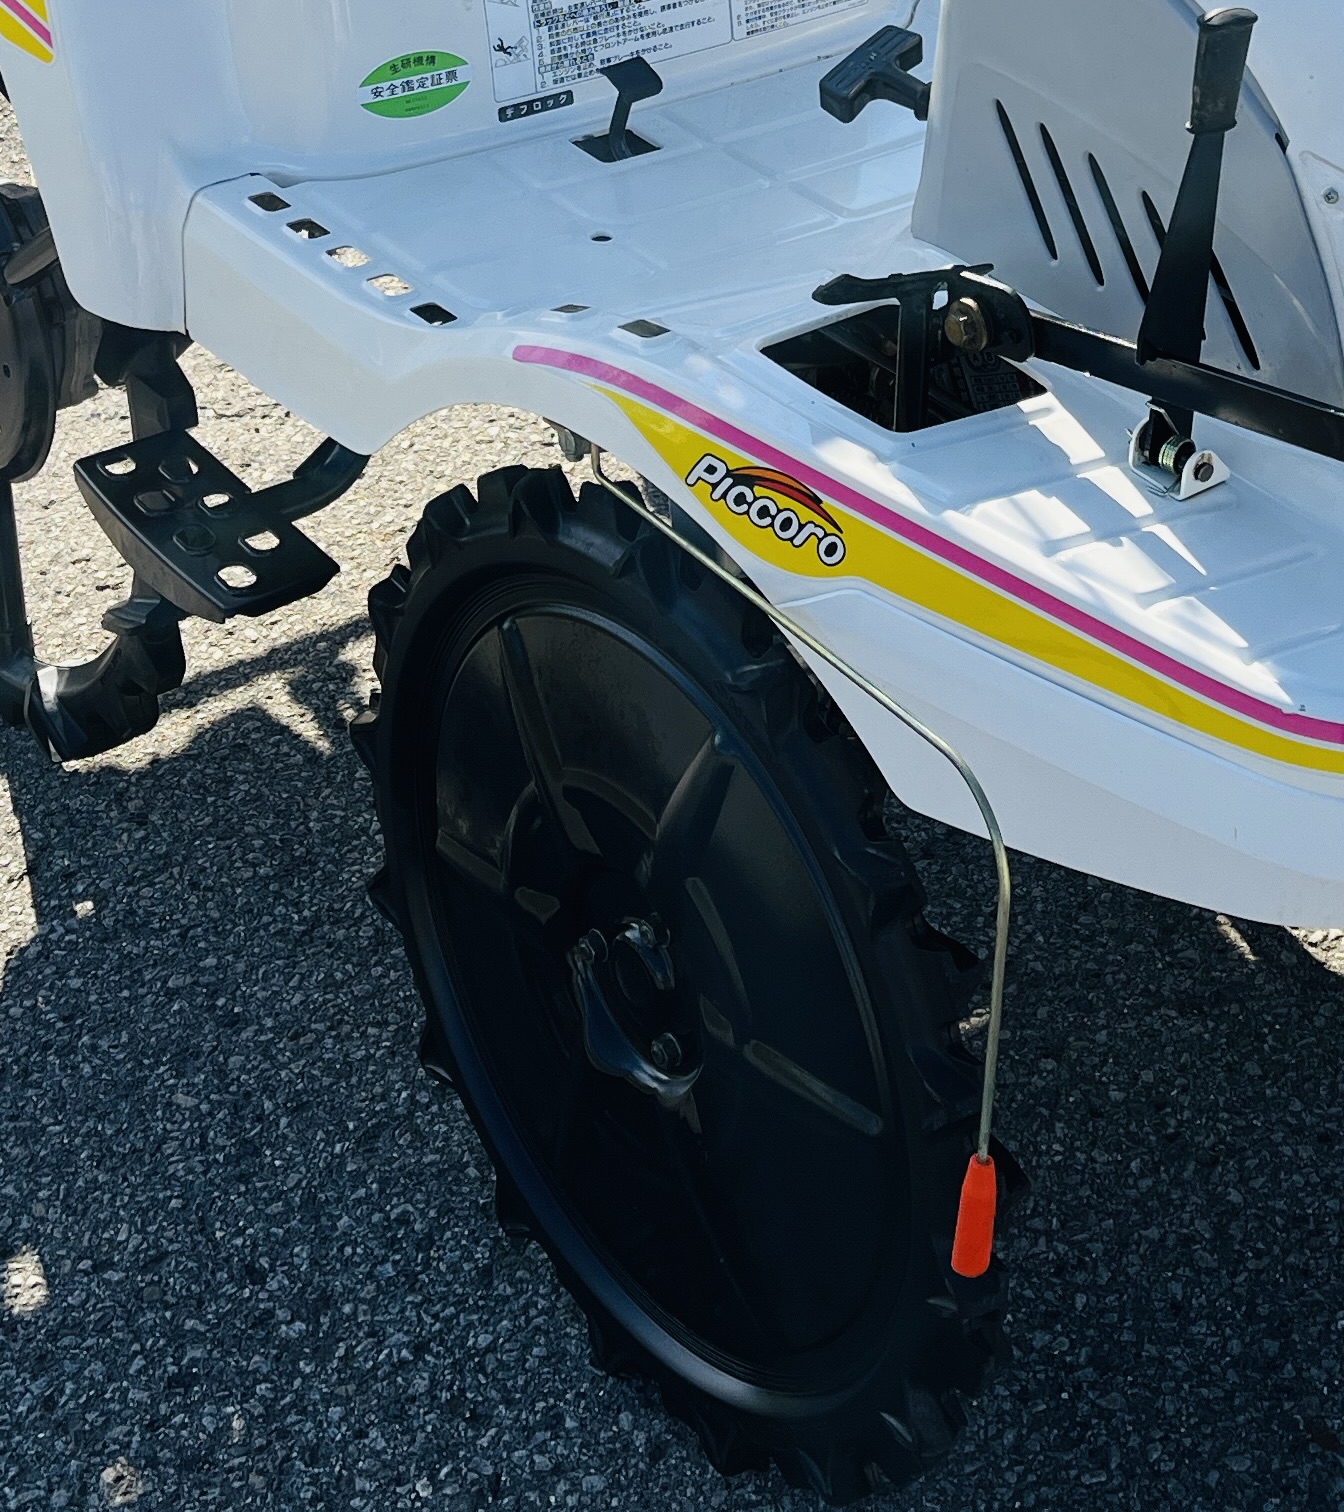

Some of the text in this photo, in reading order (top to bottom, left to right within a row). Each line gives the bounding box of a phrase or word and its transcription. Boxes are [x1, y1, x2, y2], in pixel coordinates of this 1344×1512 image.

[389, 55, 437, 76] 生研機構
[370, 69, 459, 100] 安全鑑定証票
[505, 94, 567, 119] デフロック
[685, 453, 846, 567] Piccoro
